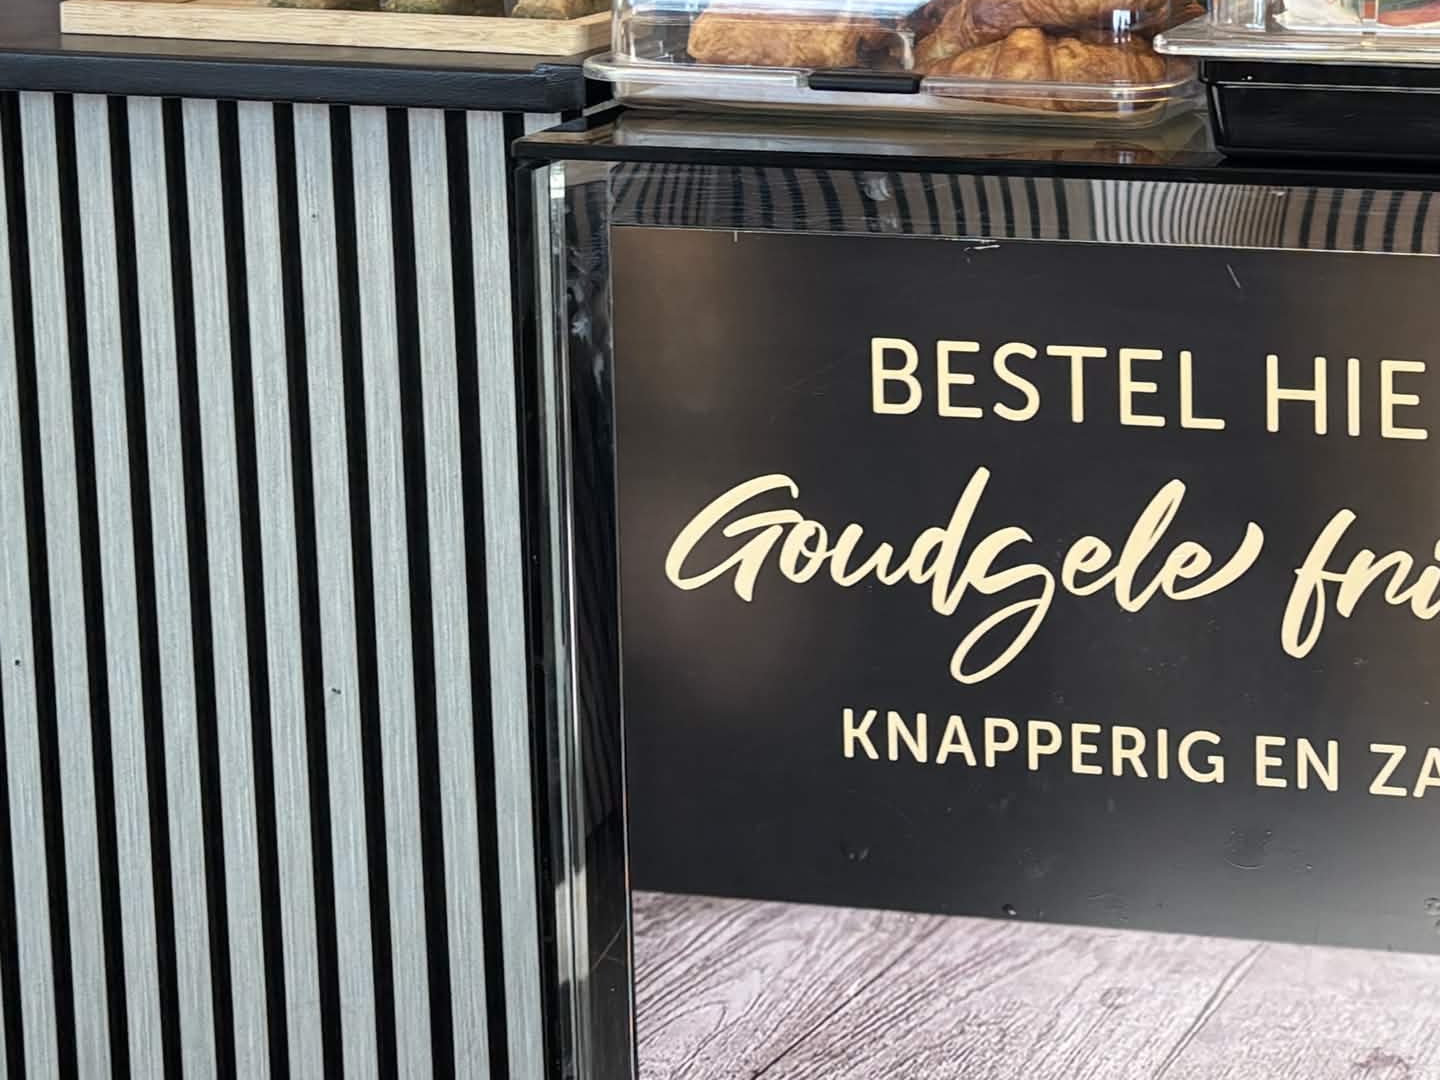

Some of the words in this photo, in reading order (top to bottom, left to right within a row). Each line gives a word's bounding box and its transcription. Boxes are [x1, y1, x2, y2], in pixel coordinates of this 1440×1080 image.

[871, 337, 1226, 430] BESTEL
[664, 466, 1264, 685] Goudgele
[842, 708, 1226, 784] KNAPPERIG
[1255, 735, 1340, 792] EN
